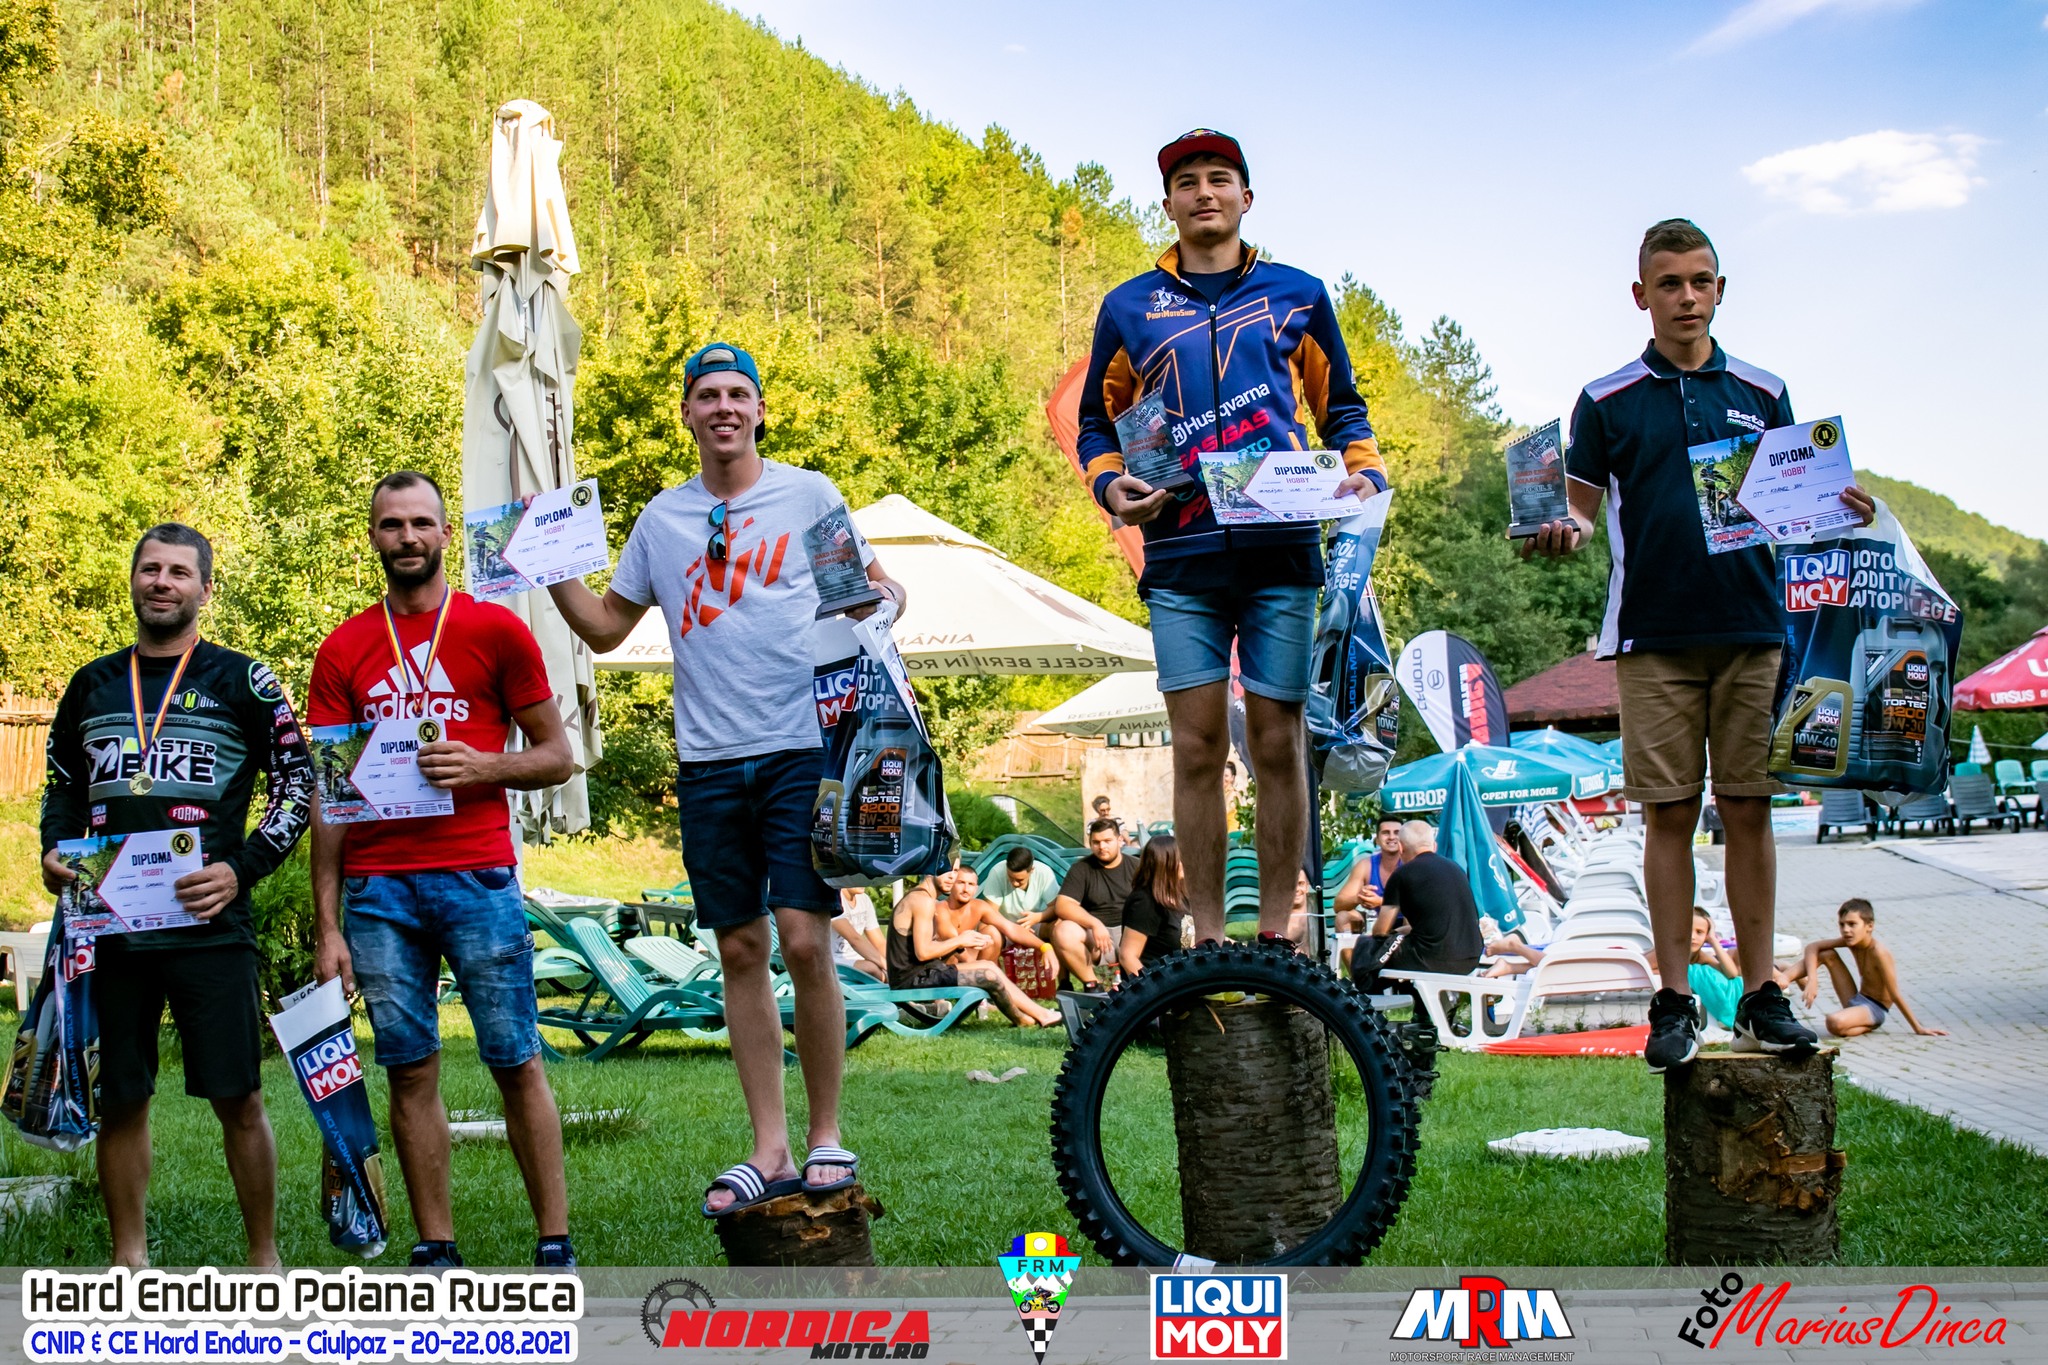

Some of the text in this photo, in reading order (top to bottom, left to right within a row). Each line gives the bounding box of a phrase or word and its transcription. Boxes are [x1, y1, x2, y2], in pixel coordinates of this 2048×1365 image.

[1183, 383, 1270, 436] Husqvarna
[1726, 408, 1765, 429] Beta
[1769, 446, 1815, 467] DIPLOMA
[1274, 466, 1317, 476] DIPLOMA
[1781, 466, 1807, 478] HOBBY
[534, 506, 574, 528] DIPLOMA
[543, 524, 566, 536] HOBBY
[1791, 552, 1846, 582] LQUI
[1791, 578, 1847, 609] MOLY
[1907, 663, 1926, 672] LIQUI
[1907, 671, 1927, 680] MOLY
[1990, 688, 2035, 704] URSUS
[363, 692, 469, 722] adidas
[1907, 700, 1927, 708] TEC
[1067, 709, 1123, 720] REGELE
[1818, 707, 1840, 717] LIQUI
[1884, 706, 1926, 720] 4200
[1376, 716, 1399, 731] 10W-
[1817, 715, 1840, 725] MOLY
[380, 739, 420, 754] DIPLOMA
[1794, 732, 1838, 749] 10W-40
[390, 757, 412, 765] HOBBY
[882, 760, 902, 769] LIQUI
[120, 752, 216, 785] BIKE
[881, 768, 902, 776] MOLY
[880, 795, 900, 803] TEC
[1391, 787, 1448, 809] TUBOR
[1481, 787, 1558, 801] OPEN FOR MORE
[171, 806, 206, 821] FORMA
[860, 803, 900, 813] 4200
[859, 813, 899, 826] 5W-30
[131, 851, 173, 867] DIPLOMA
[141, 868, 164, 877] HOBBY
[302, 1032, 356, 1076] LIQU
[310, 1055, 363, 1098] MOL
[541, 1244, 562, 1252] adidas
